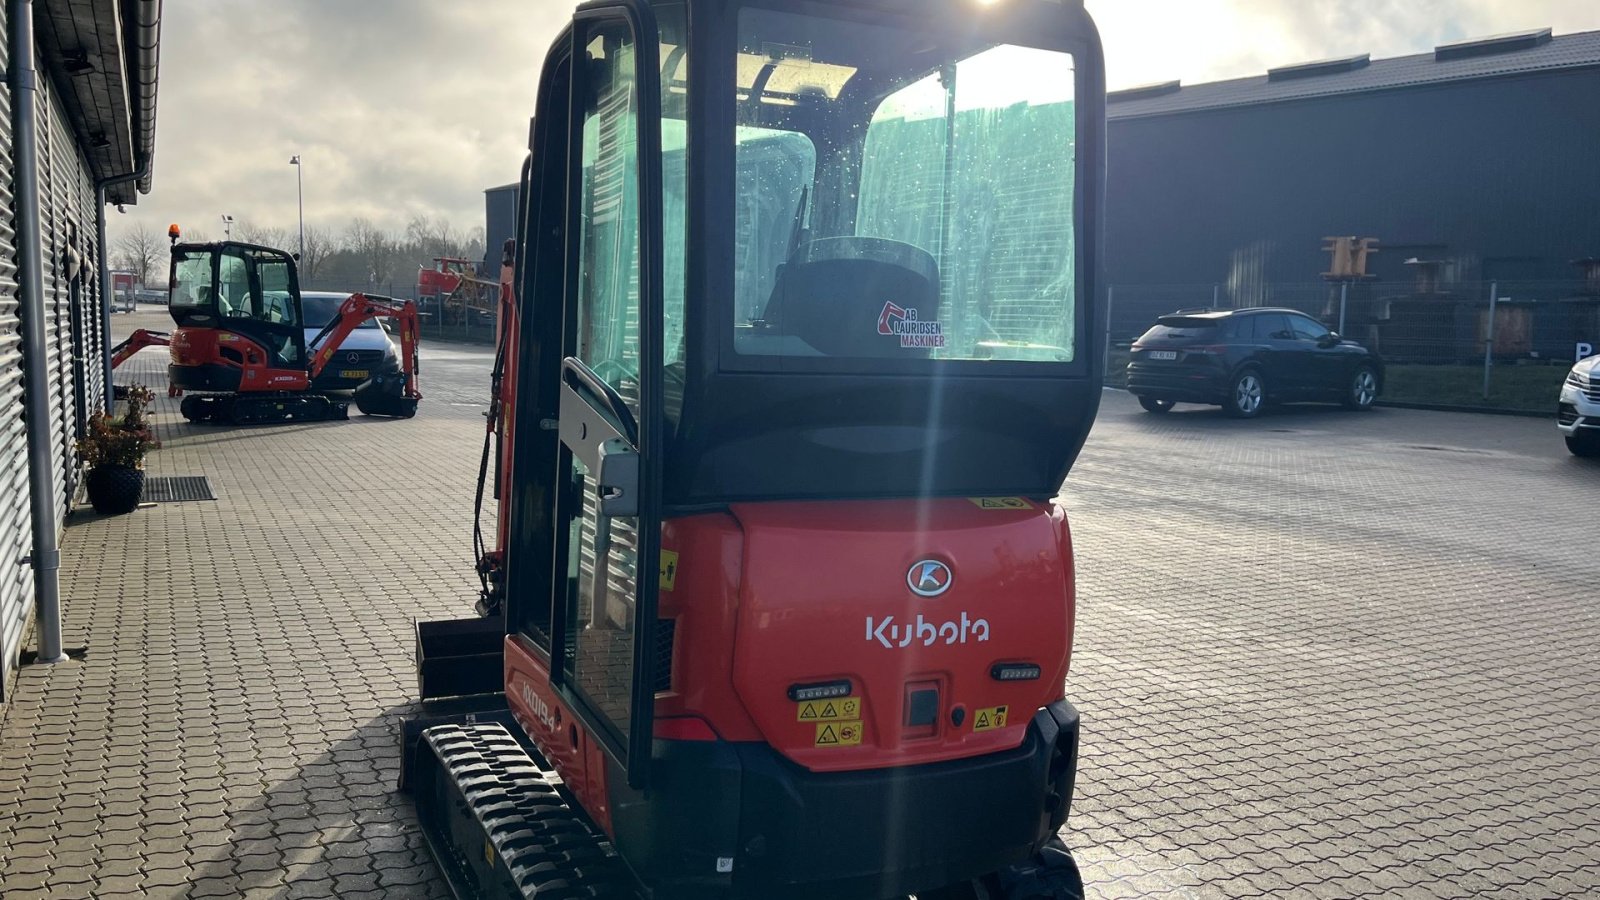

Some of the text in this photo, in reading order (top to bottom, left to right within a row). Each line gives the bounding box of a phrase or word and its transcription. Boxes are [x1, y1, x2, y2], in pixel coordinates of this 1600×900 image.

[905, 309, 917, 321] AB
[894, 322, 941, 334] LAURIDSEN
[901, 335, 944, 347] MASKINER
[1576, 342, 1592, 361] P
[865, 611, 990, 648] Kubota
